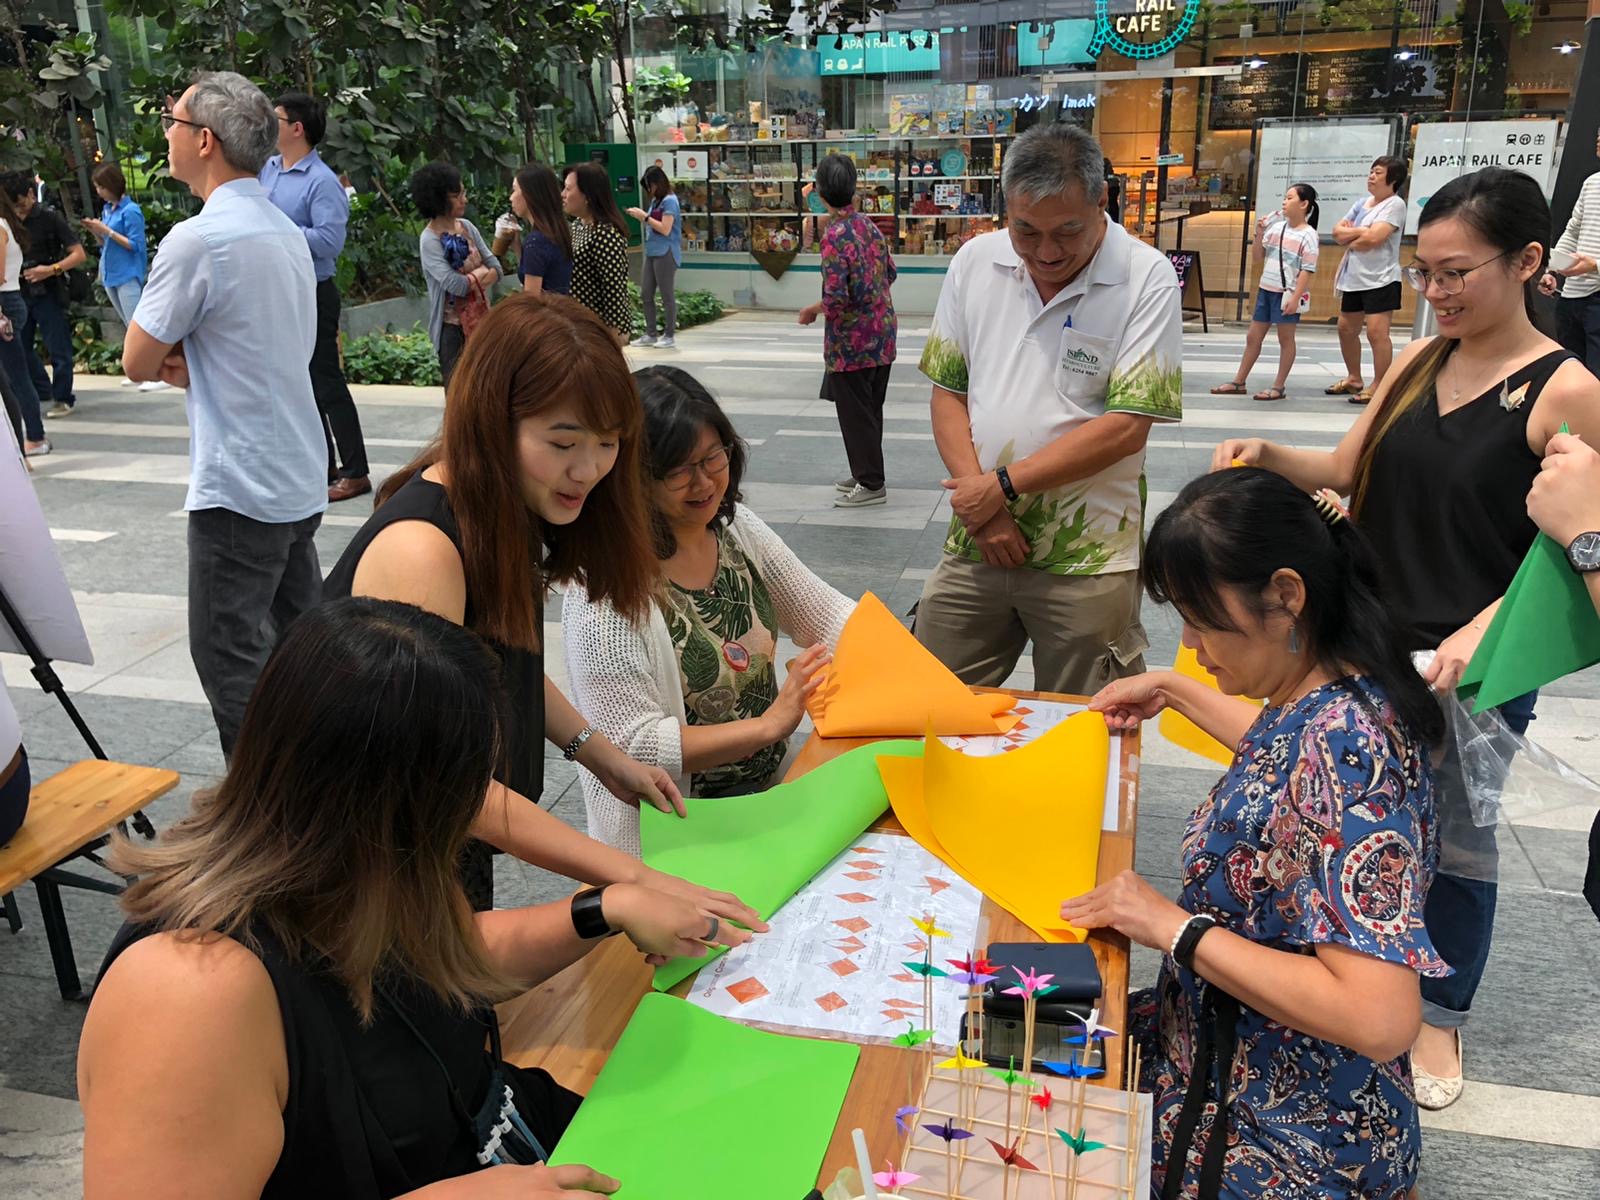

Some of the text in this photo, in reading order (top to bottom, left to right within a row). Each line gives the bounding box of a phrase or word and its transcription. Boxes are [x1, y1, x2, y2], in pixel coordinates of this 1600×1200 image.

[1135, 0, 1176, 12] RAIL
[1116, 14, 1162, 33] CAFE
[838, 37, 871, 50] APAN
[873, 38, 897, 49] RAIL
[899, 35, 925, 48] PSS
[1422, 153, 1543, 167] JAPAN RAIL CAFE
